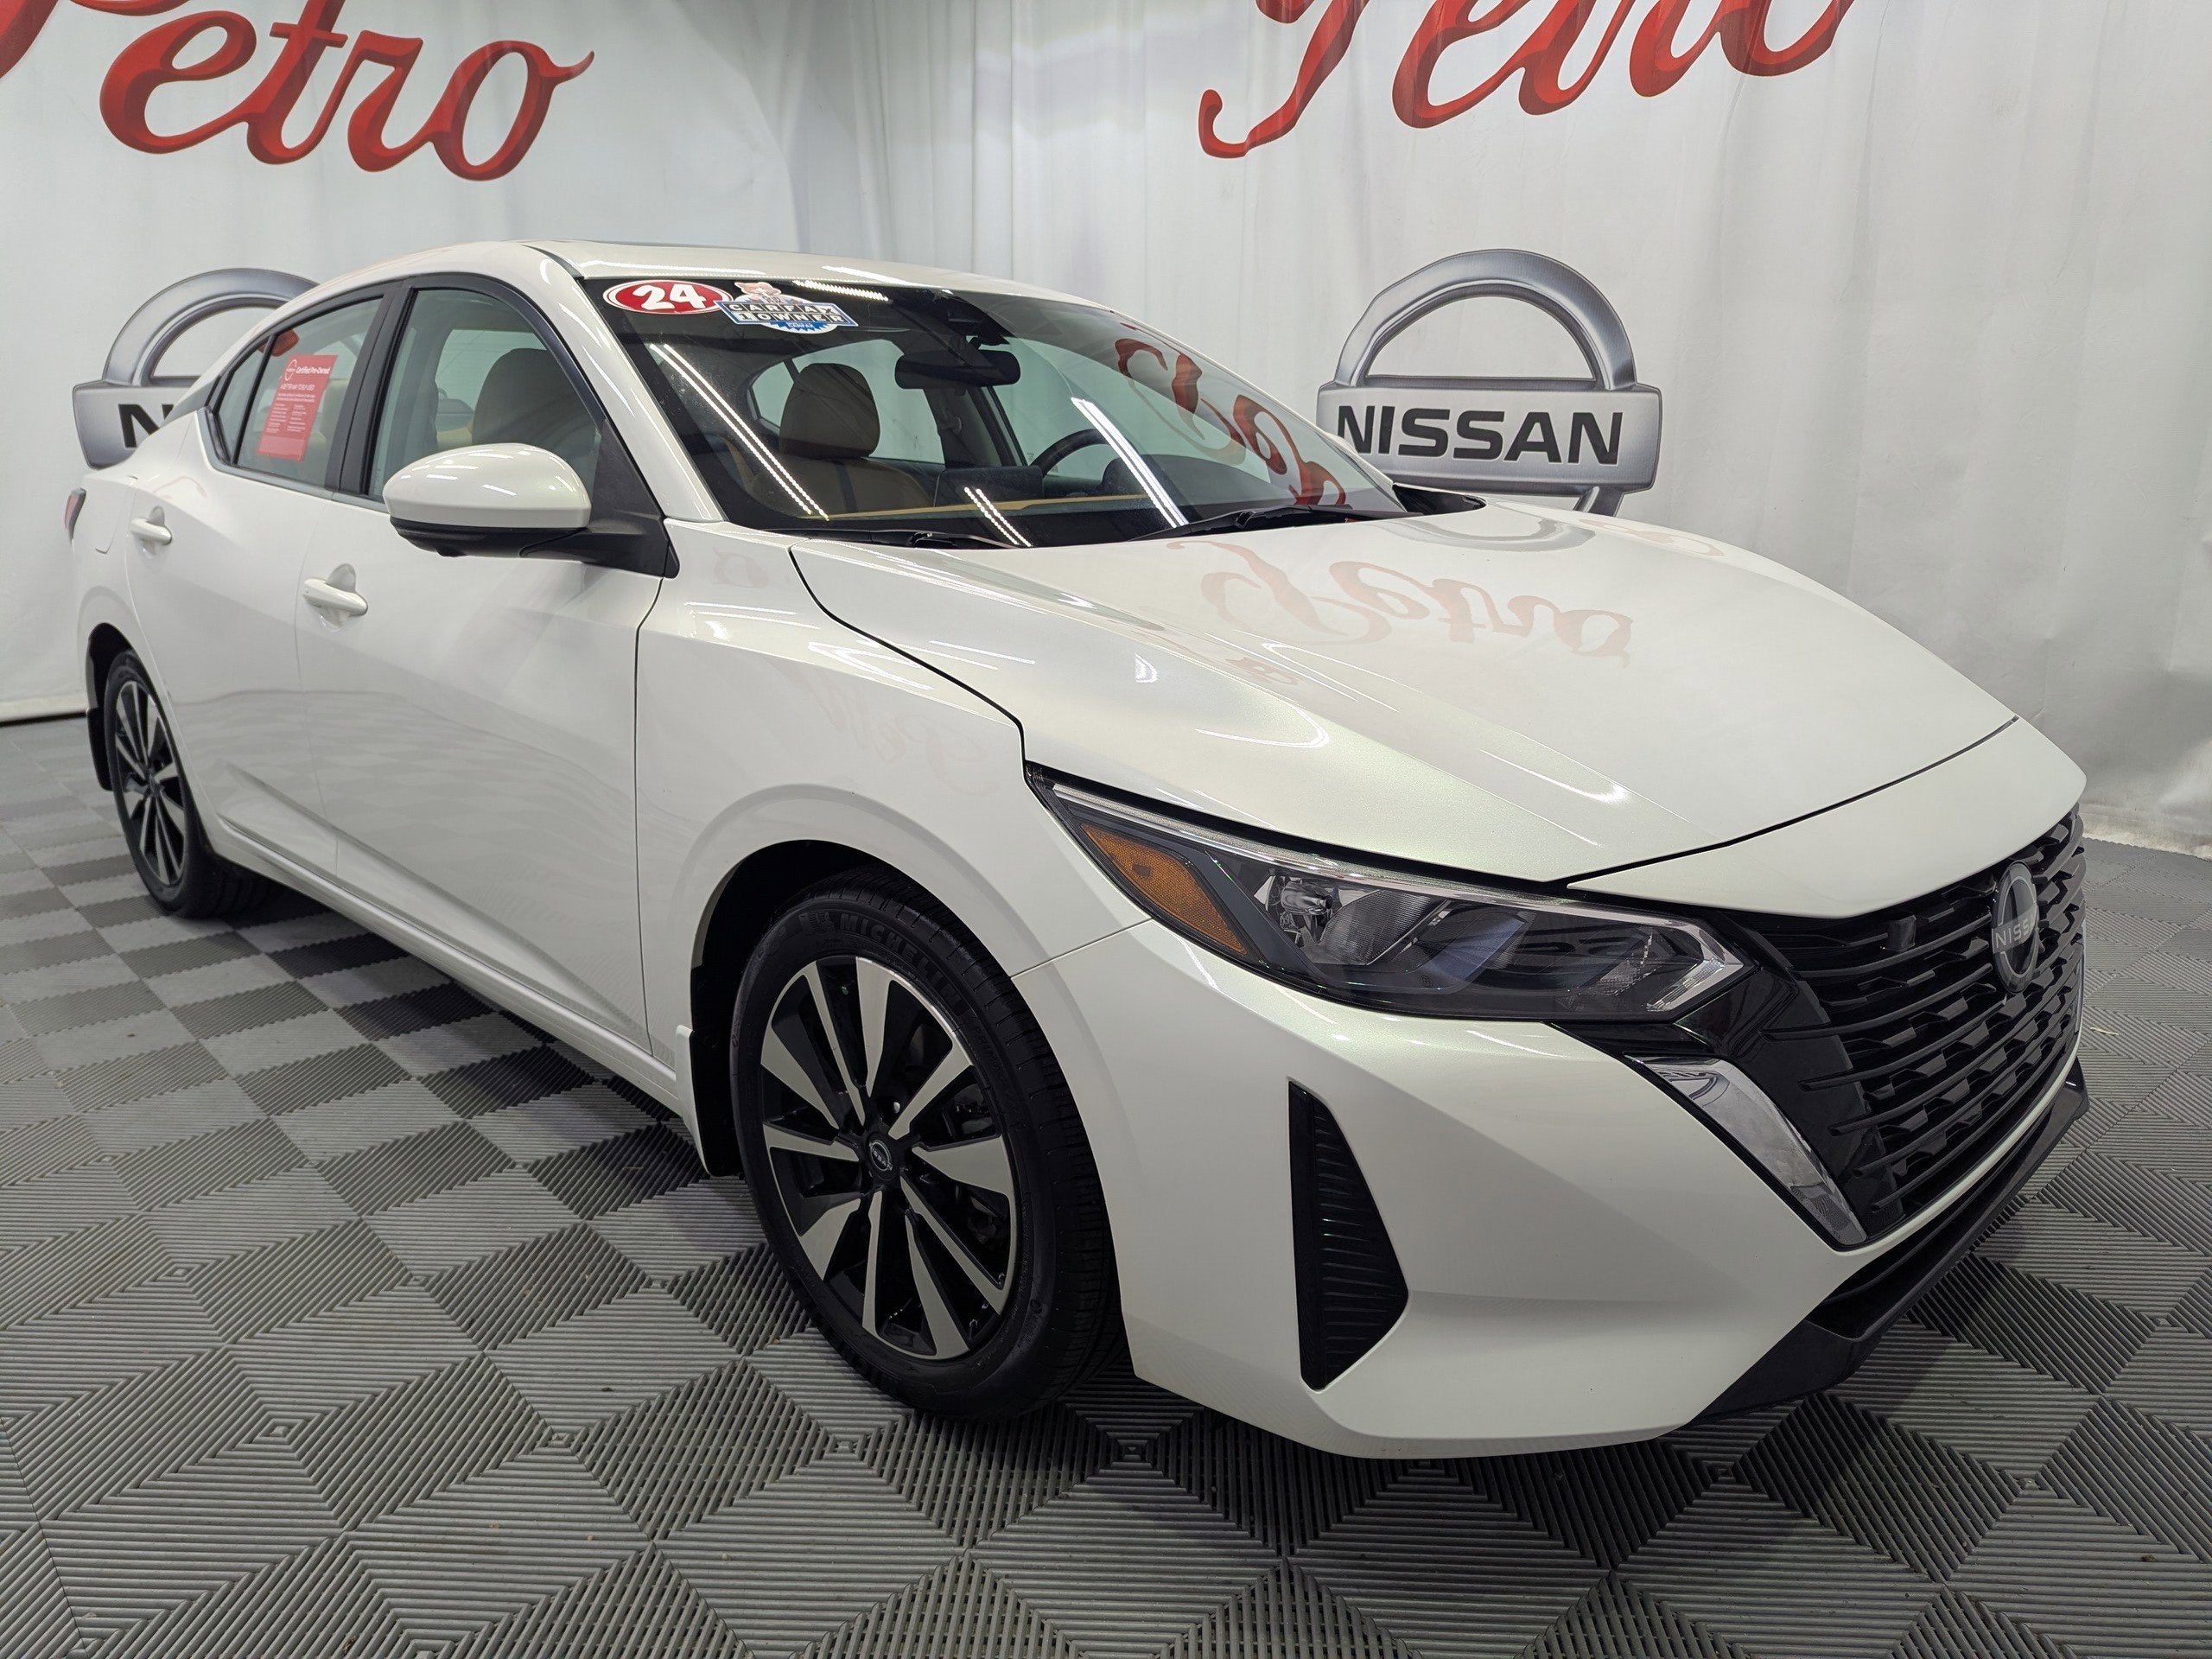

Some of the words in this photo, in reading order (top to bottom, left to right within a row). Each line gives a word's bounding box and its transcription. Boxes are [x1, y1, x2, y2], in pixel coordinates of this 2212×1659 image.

[632, 283, 707, 310] 24
[728, 303, 836, 315] CARFAX
[737, 312, 753, 321] 1
[757, 313, 846, 323] OWNER
[1338, 405, 1623, 466] NISSAN
[839, 913, 963, 1009] MICHELIN
